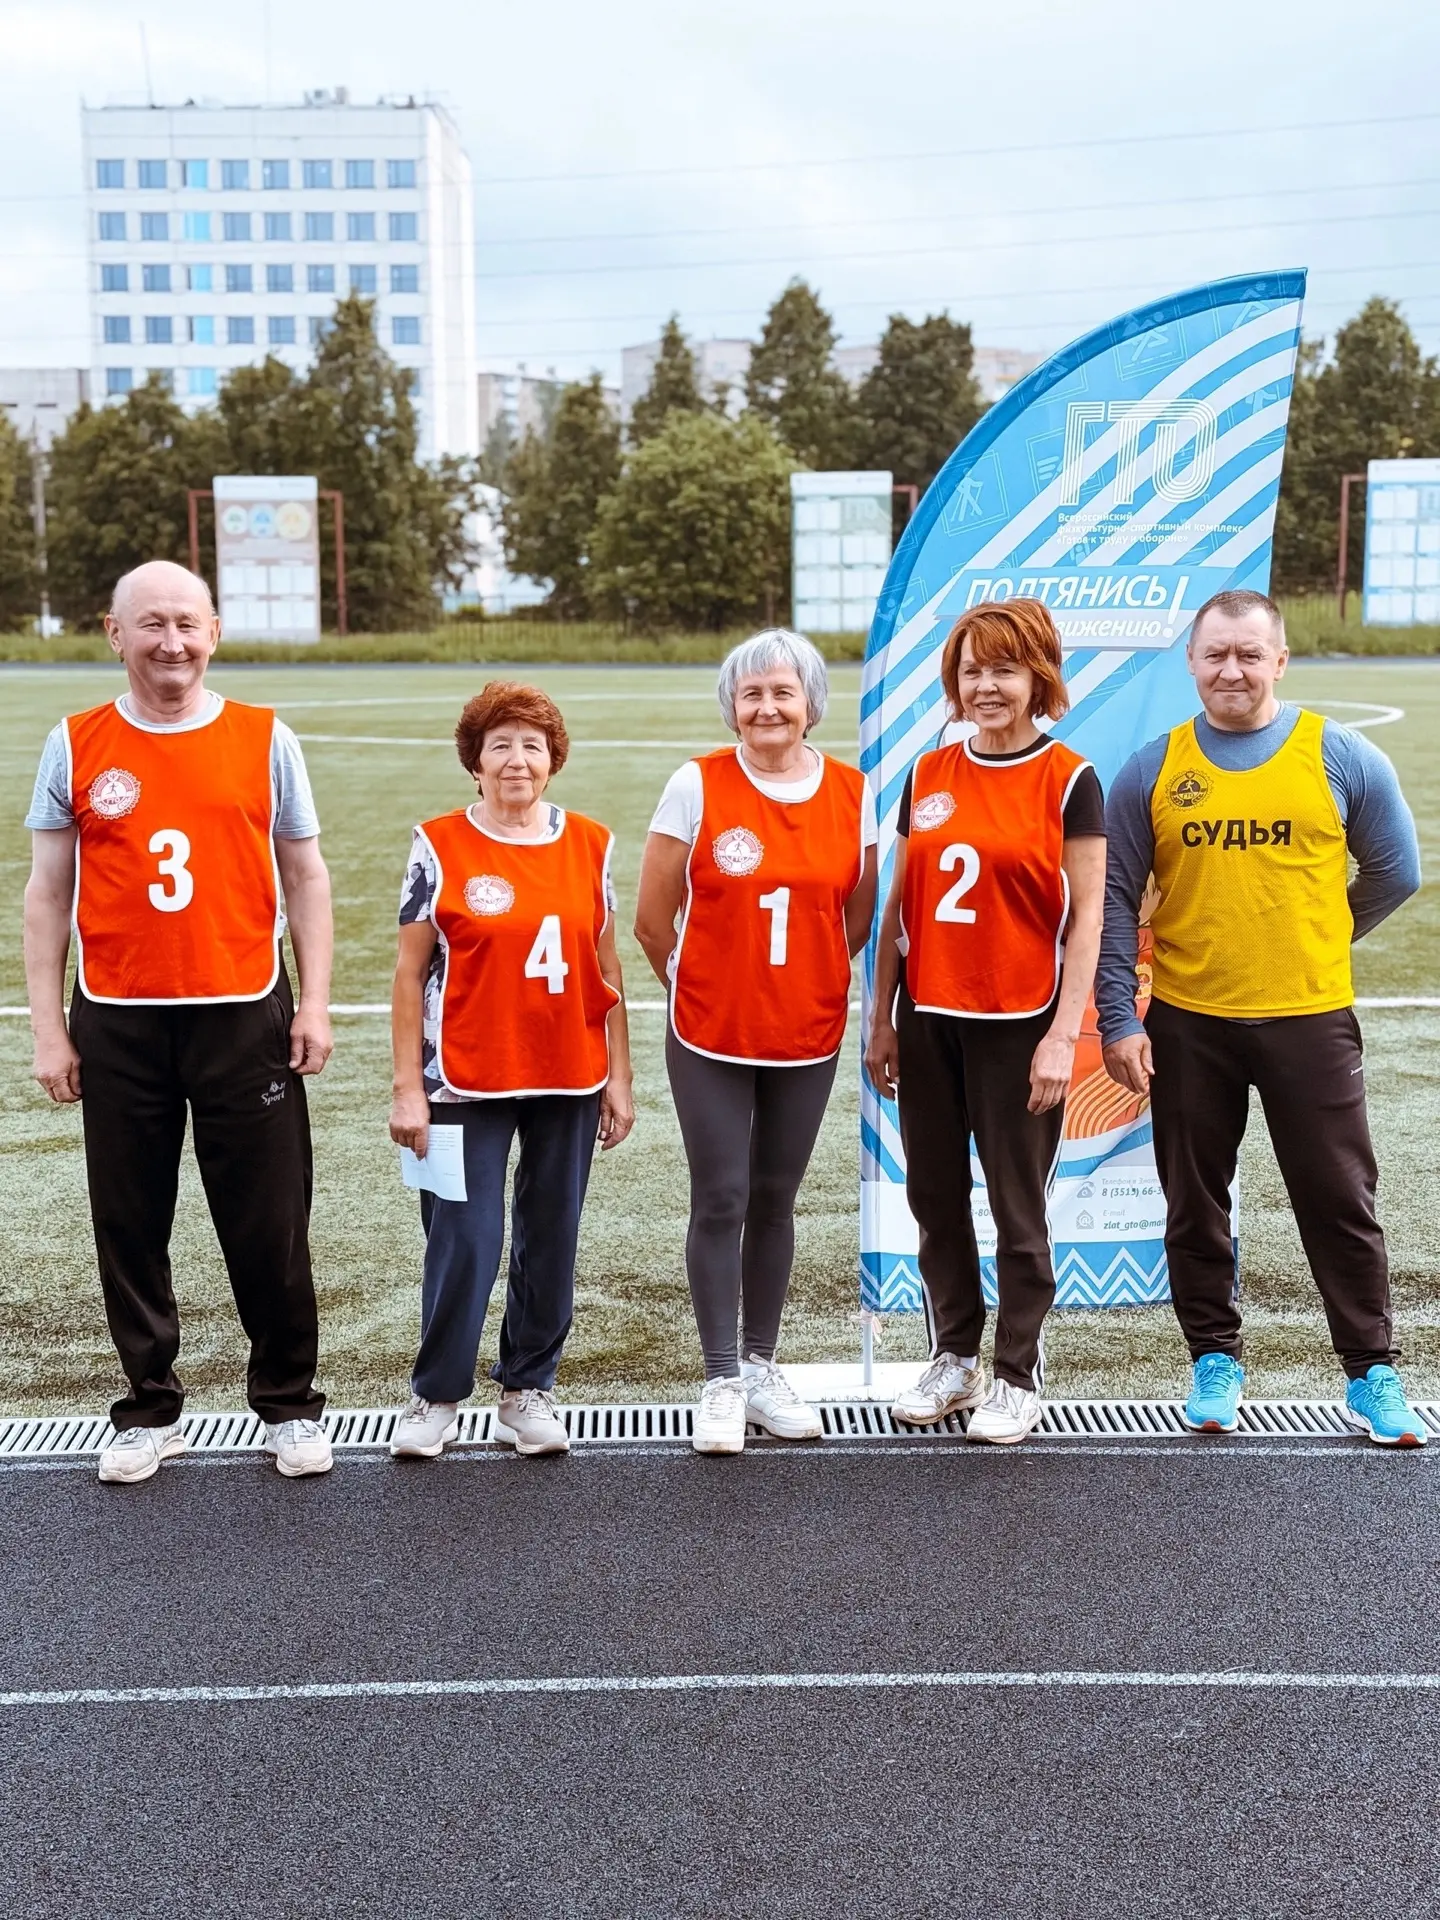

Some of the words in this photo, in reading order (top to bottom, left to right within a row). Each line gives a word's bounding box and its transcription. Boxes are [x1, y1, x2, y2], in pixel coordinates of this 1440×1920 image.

[1059, 398, 1218, 506] ГТО
[1057, 511, 1134, 525] Всероссийский
[1194, 523, 1244, 534] комплекс
[1099, 535, 1129, 546] труду
[1181, 819, 1292, 851] СУДЬЯ
[148, 828, 194, 913] 3
[934, 842, 981, 924] 2
[759, 886, 790, 966] 1
[524, 914, 569, 994] 4
[260, 1090, 285, 1106] Sport
[1101, 1187, 1108, 1197] 8
